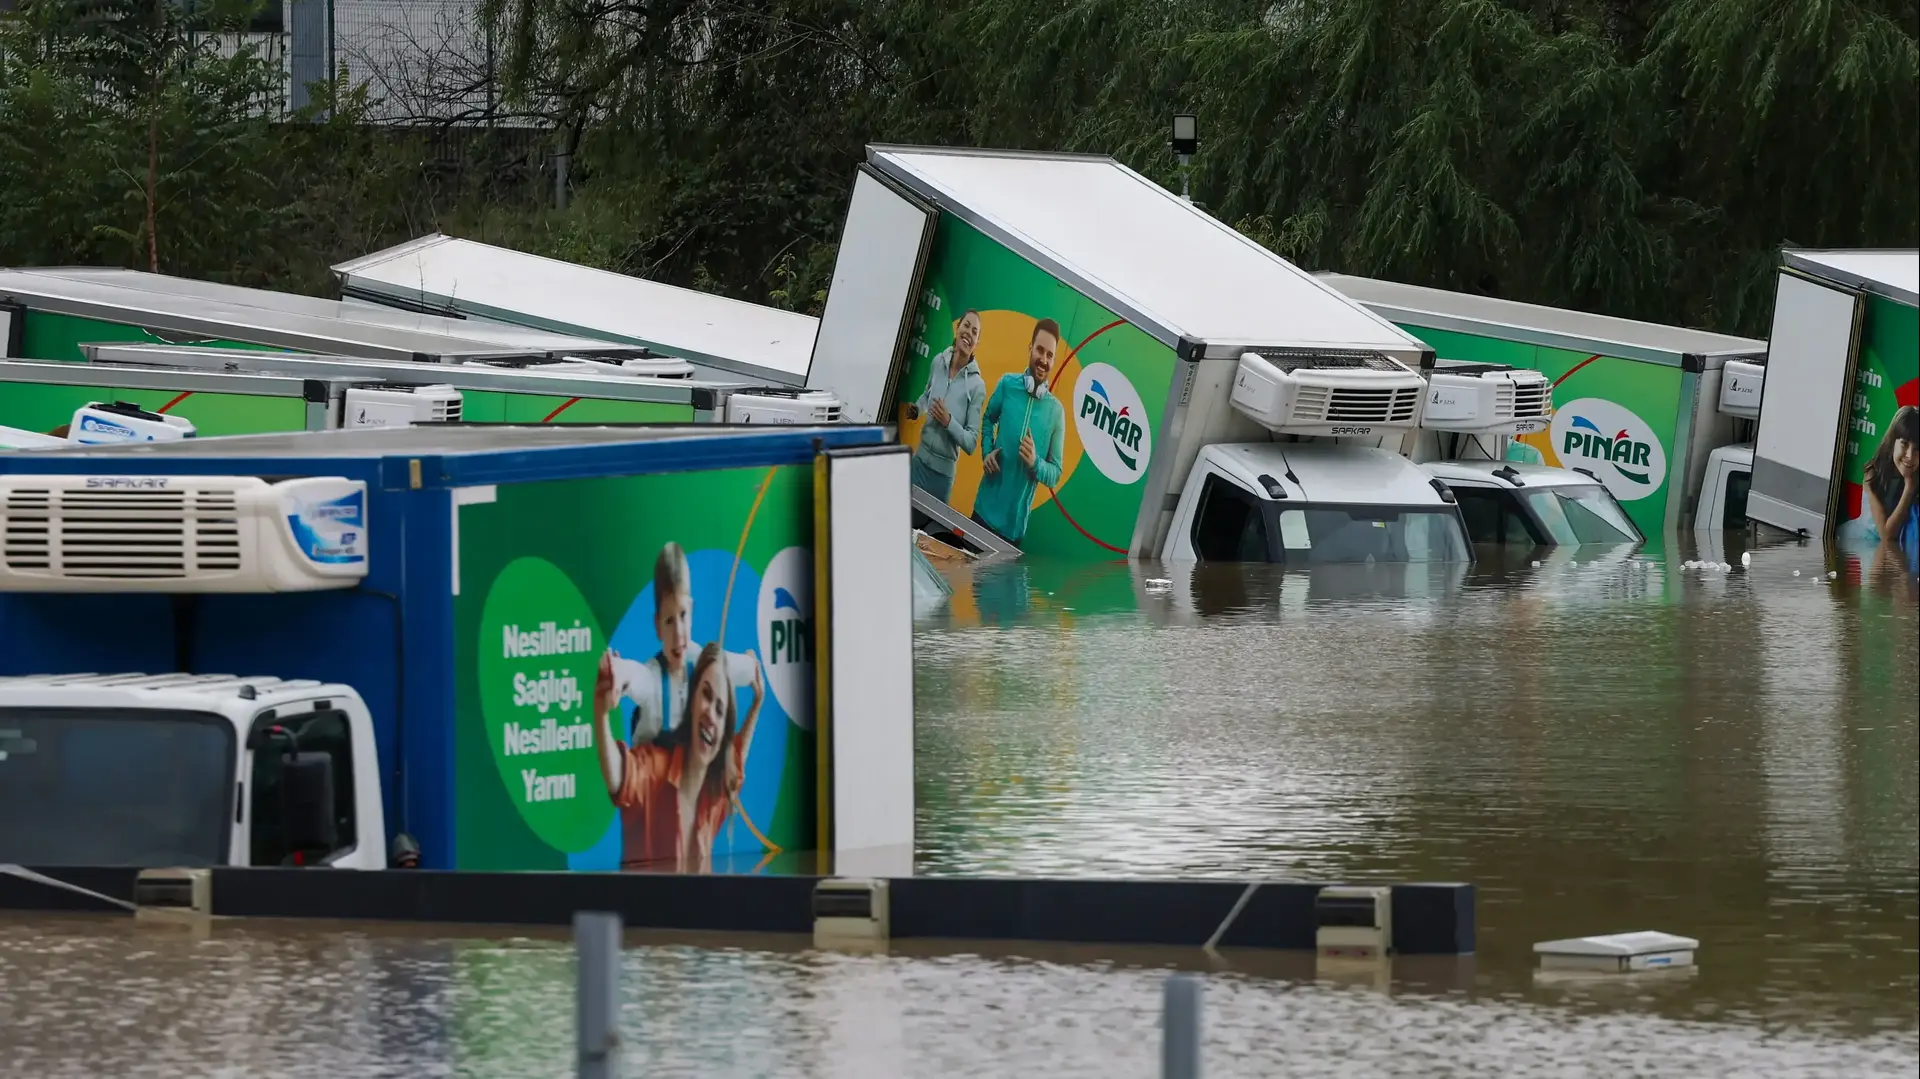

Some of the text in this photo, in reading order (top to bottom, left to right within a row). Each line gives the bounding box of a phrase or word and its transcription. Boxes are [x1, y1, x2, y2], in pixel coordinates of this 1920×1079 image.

[1080, 393, 1143, 453] PINAR
[1331, 427, 1371, 435] SAFKAR
[1563, 431, 1651, 467] PINAR
[86, 478, 168, 488] SAFKAR
[503, 620, 592, 658] Nesillerin
[771, 617, 815, 664] PIN
[513, 669, 583, 713] Sağlığı,
[504, 716, 593, 756] Nesillerin
[521, 768, 576, 802] Yarını
